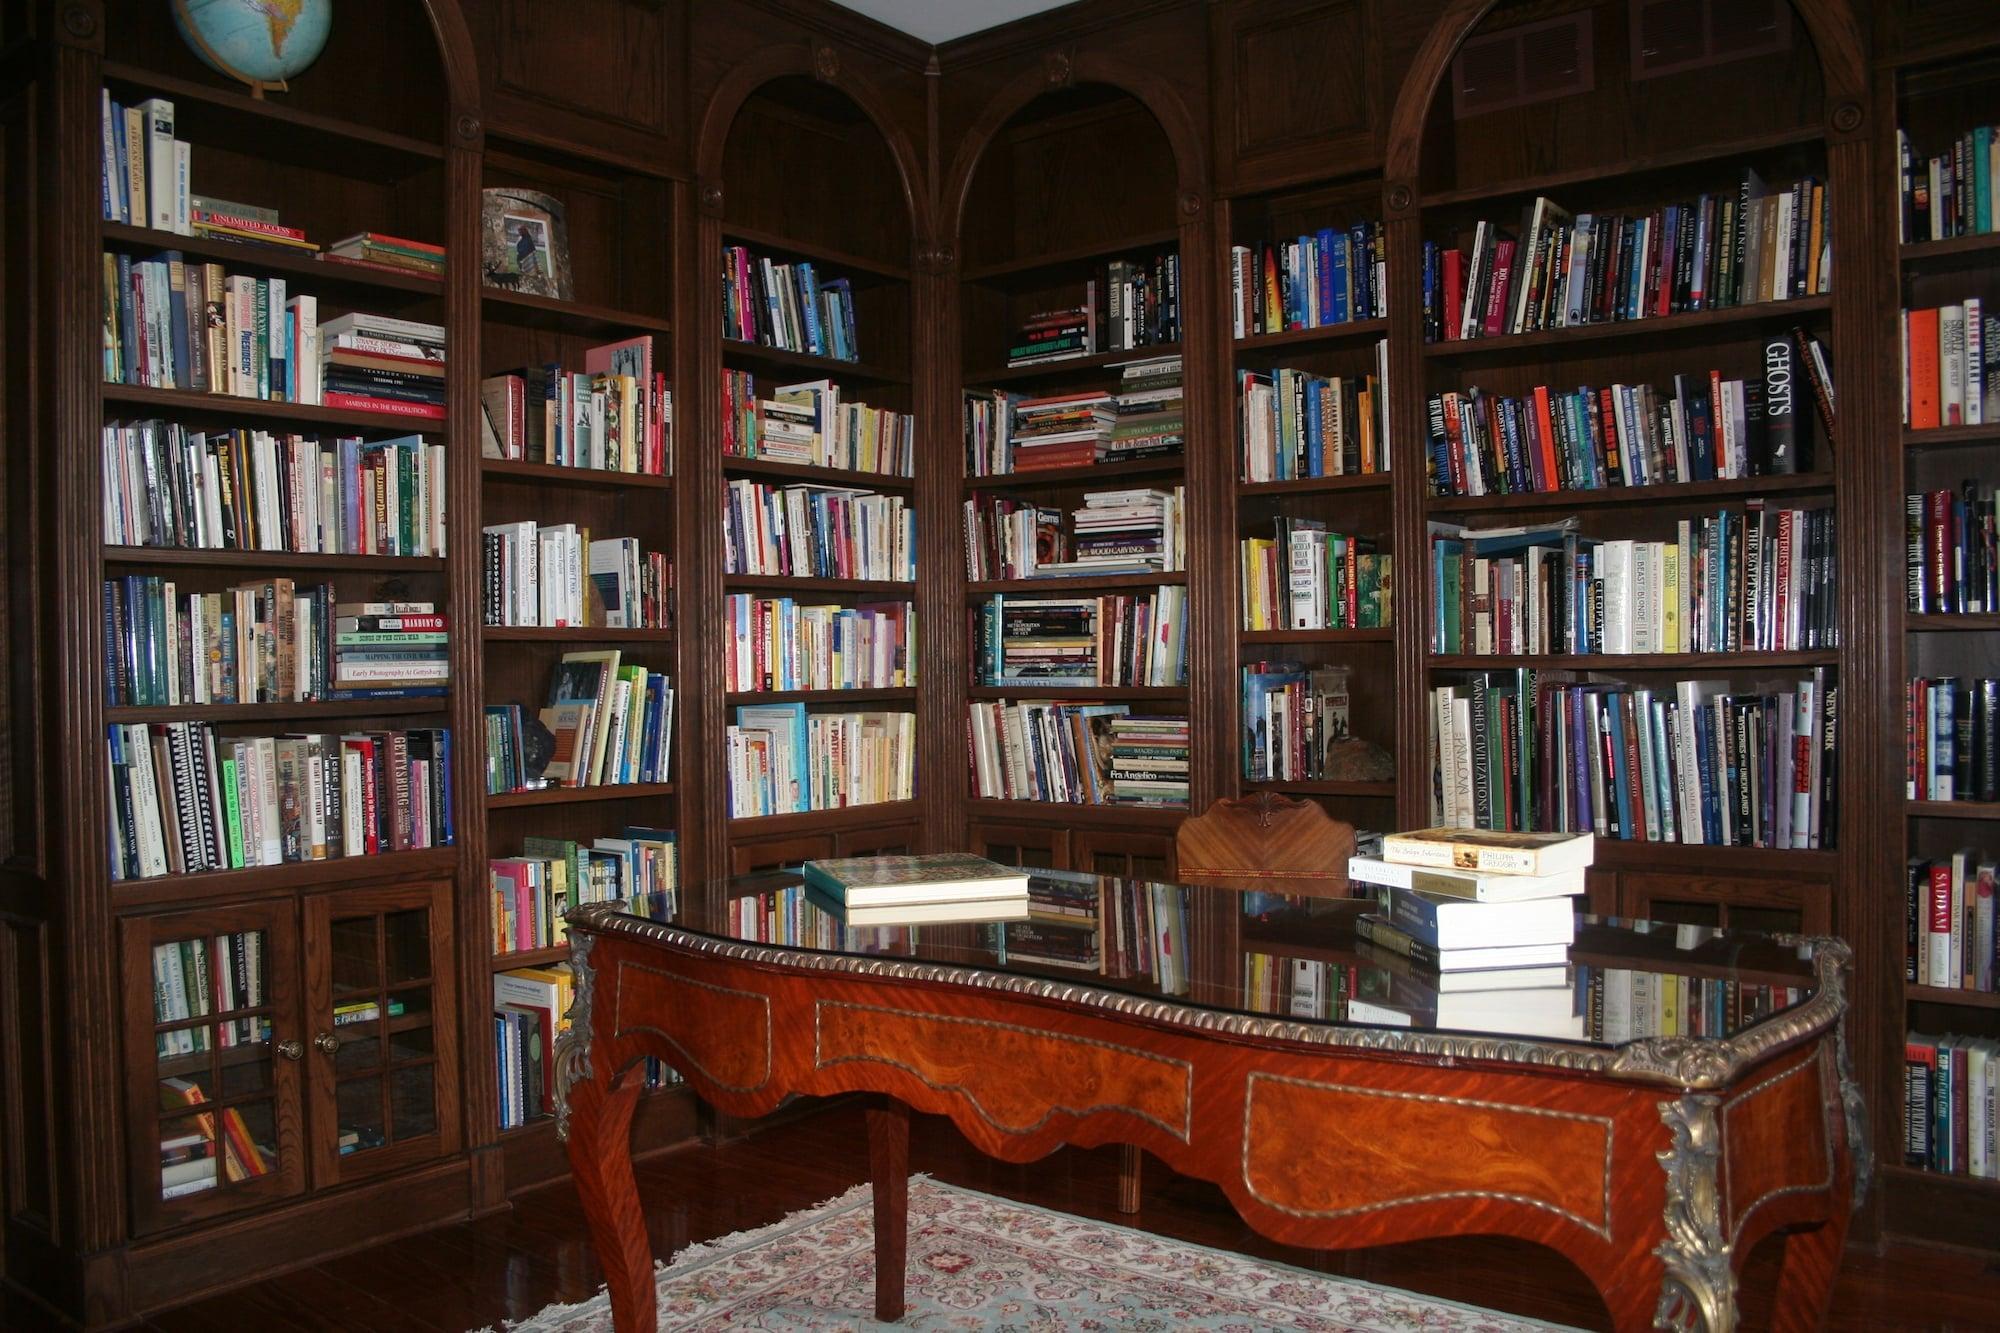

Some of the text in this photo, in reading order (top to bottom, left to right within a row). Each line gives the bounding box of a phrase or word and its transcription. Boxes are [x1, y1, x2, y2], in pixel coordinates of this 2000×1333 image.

[1736, 182, 1749, 264] HAUNTINGS
[241, 330, 251, 376] PRESIDENCY
[1951, 319, 1963, 355] SMALL
[1969, 306, 1980, 384] RAGING HEART
[1765, 341, 1792, 416] GHOSTS
[1497, 403, 1506, 432] GHOSTS
[1907, 494, 1923, 515] DINO
[528, 539, 537, 557] How
[1779, 514, 1790, 566] MYSTERIES
[1709, 557, 1718, 584] GOLD
[1745, 527, 1758, 624] THE EGYPT STORY
[1595, 581, 1603, 644] CLEOPATRA
[1529, 673, 1537, 708] CANADA
[1825, 691, 1836, 750] NEW YORK
[1472, 678, 1487, 812] VANISHED CIVILIZATIONS
[1682, 699, 1691, 733] NORMAN
[1687, 787, 1696, 822] AMERICA
[329, 754, 340, 782] Jesse
[393, 737, 409, 806] GETTYSBURG
[1110, 770, 1123, 779] Fra
[1737, 716, 1749, 816] MYSTERIES UNEXPLAINED
[330, 785, 341, 820] James
[1482, 851, 1515, 861] PHILIPPA
[1483, 859, 1517, 868] GREGORY
[1935, 873, 1947, 929] SADDAM
[1987, 1099, 1995, 1129] WARRIOR
[1987, 1131, 1995, 1154] WITHIN
